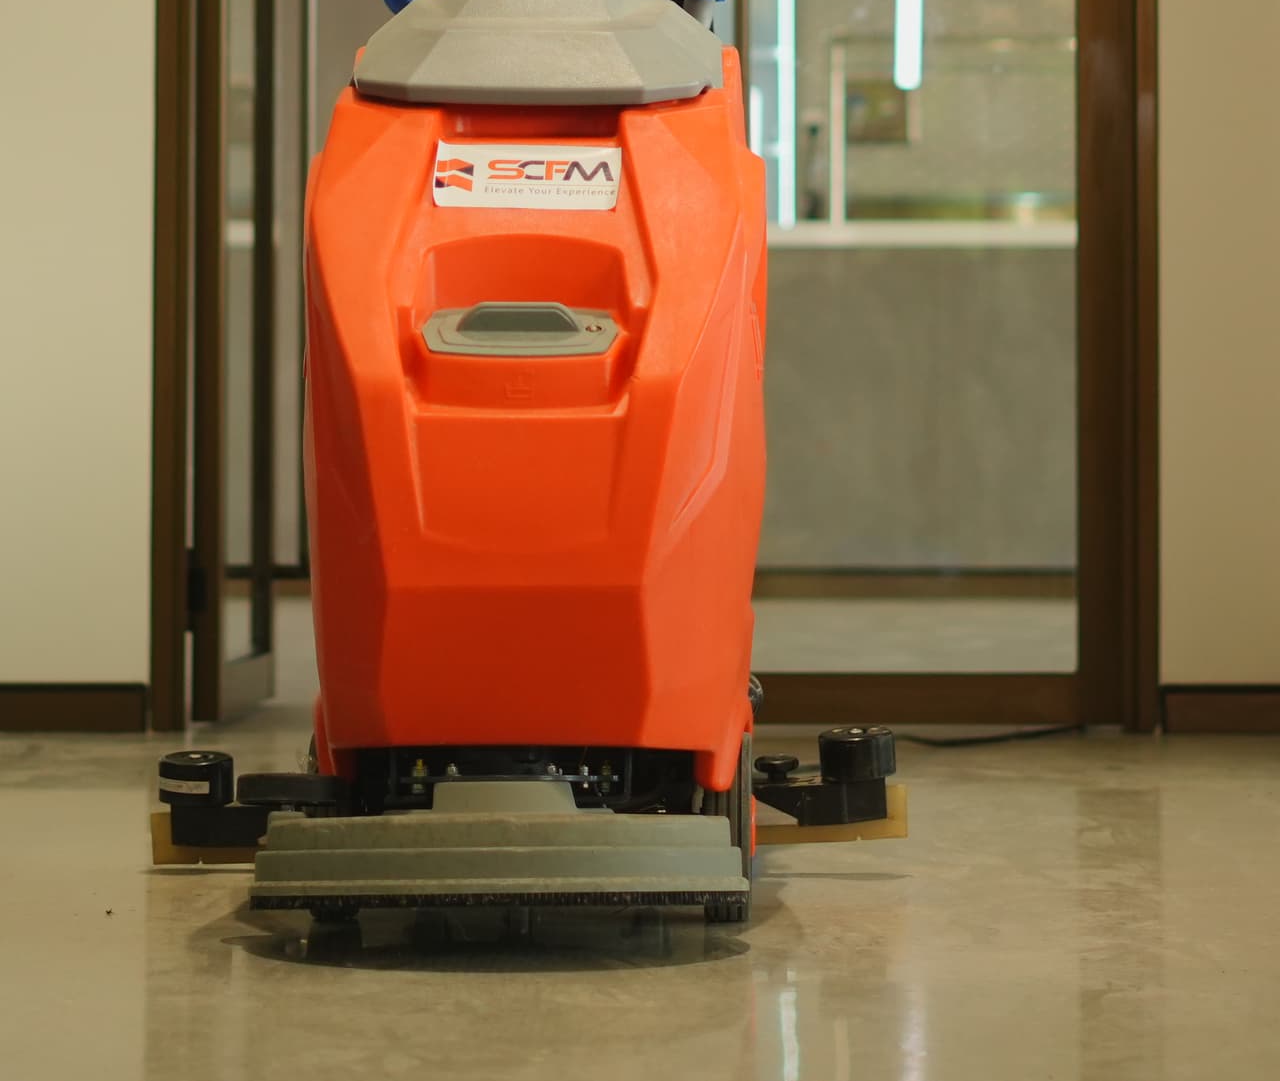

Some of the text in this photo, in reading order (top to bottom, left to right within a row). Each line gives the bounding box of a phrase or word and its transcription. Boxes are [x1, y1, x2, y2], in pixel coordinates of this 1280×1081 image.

[487, 159, 615, 182] SCFM
[484, 185, 617, 197] Elevate Your Experience
